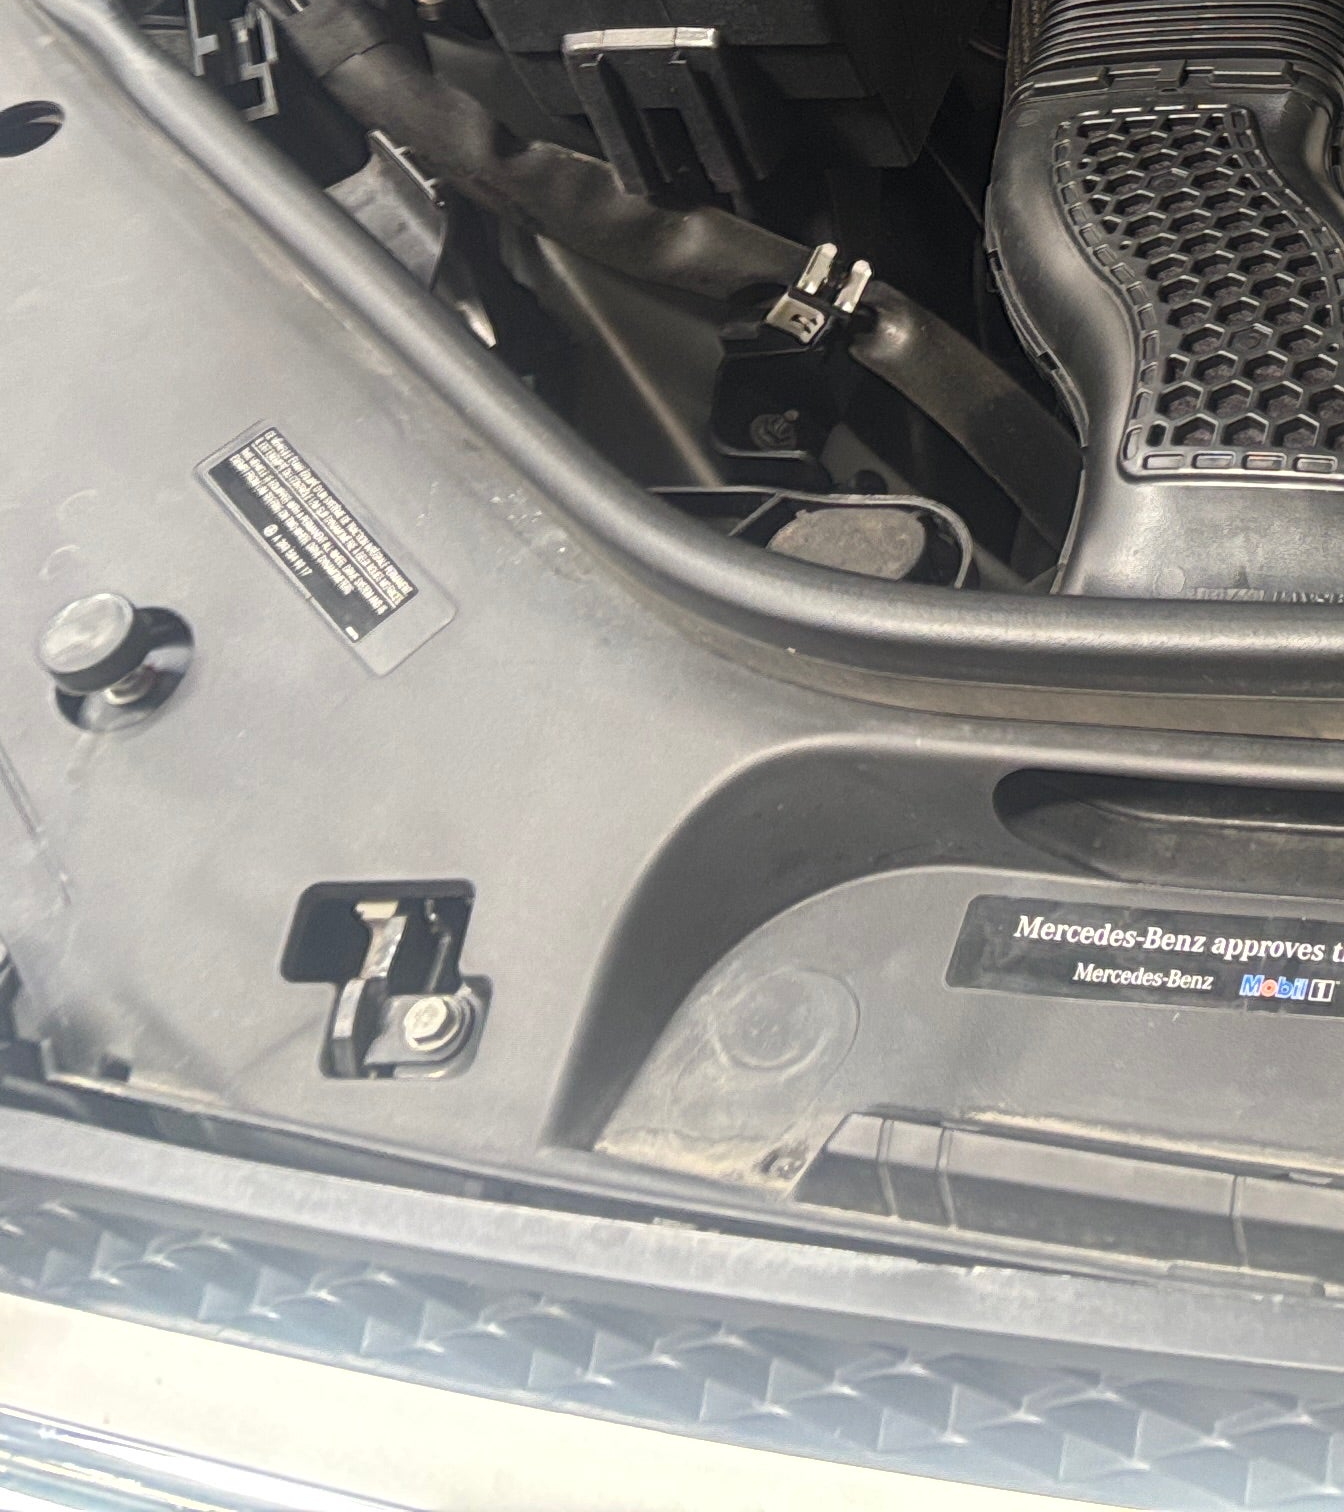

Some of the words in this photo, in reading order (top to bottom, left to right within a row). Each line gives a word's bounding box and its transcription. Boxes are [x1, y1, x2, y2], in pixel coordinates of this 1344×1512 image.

[1013, 915, 1206, 954] Mercedes-Benz
[1210, 934, 1325, 962] approves
[1072, 962, 1214, 992] Mercedes-Benz
[1239, 974, 1309, 1001] Mobil
